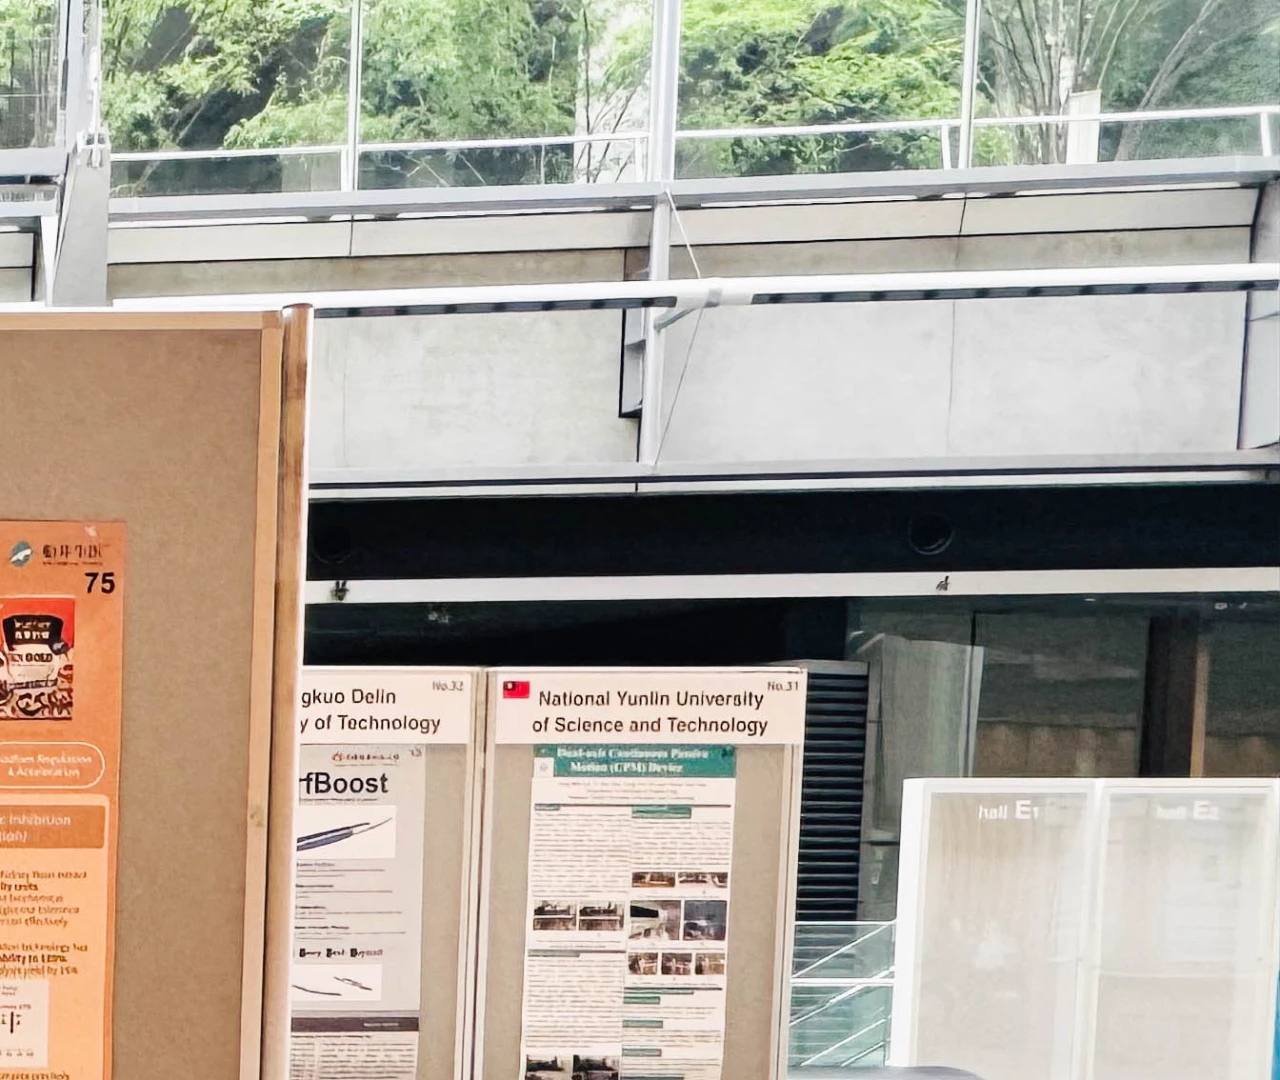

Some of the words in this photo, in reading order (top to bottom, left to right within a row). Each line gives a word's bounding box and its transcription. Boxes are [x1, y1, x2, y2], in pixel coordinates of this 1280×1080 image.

[84, 571, 116, 594] 75
[351, 687, 397, 705] Delin
[539, 690, 611, 707] National
[616, 690, 671, 707] Yunlin
[676, 690, 765, 711] University
[314, 714, 332, 731] of
[336, 714, 442, 735] Technology
[532, 716, 550, 733] of
[554, 716, 624, 733] Science
[628, 716, 662, 733] and
[667, 716, 769, 737] Technology
